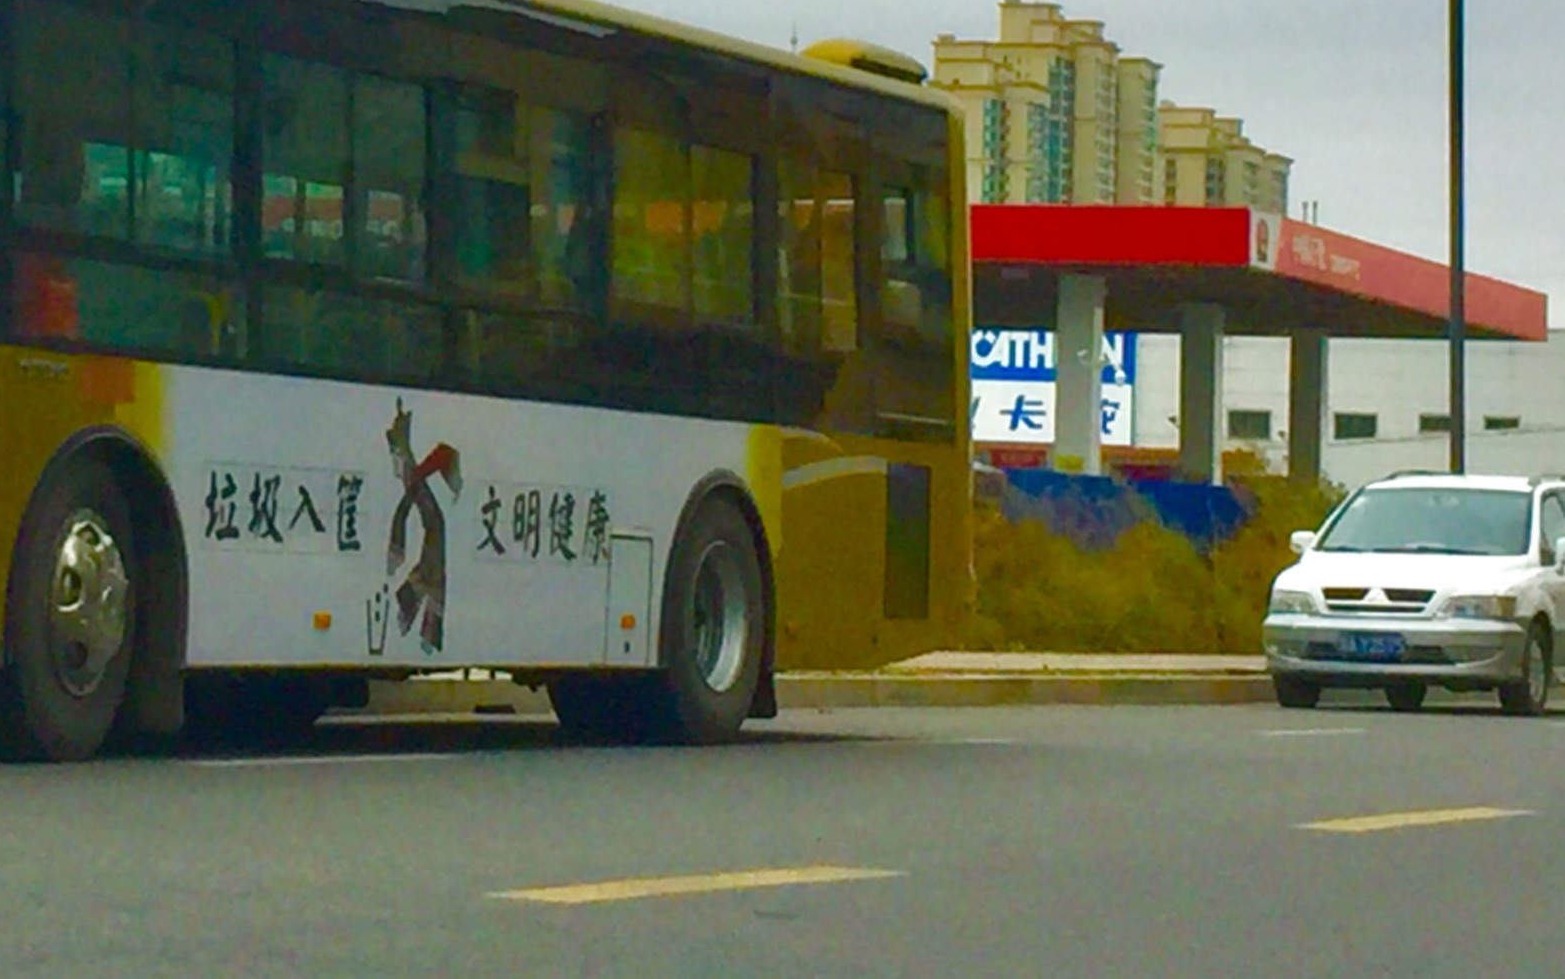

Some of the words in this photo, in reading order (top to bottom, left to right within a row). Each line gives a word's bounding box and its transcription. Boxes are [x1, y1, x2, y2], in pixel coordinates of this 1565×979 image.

[205, 471, 363, 551] 垃圾入筐
[477, 485, 611, 566] 文明健康
